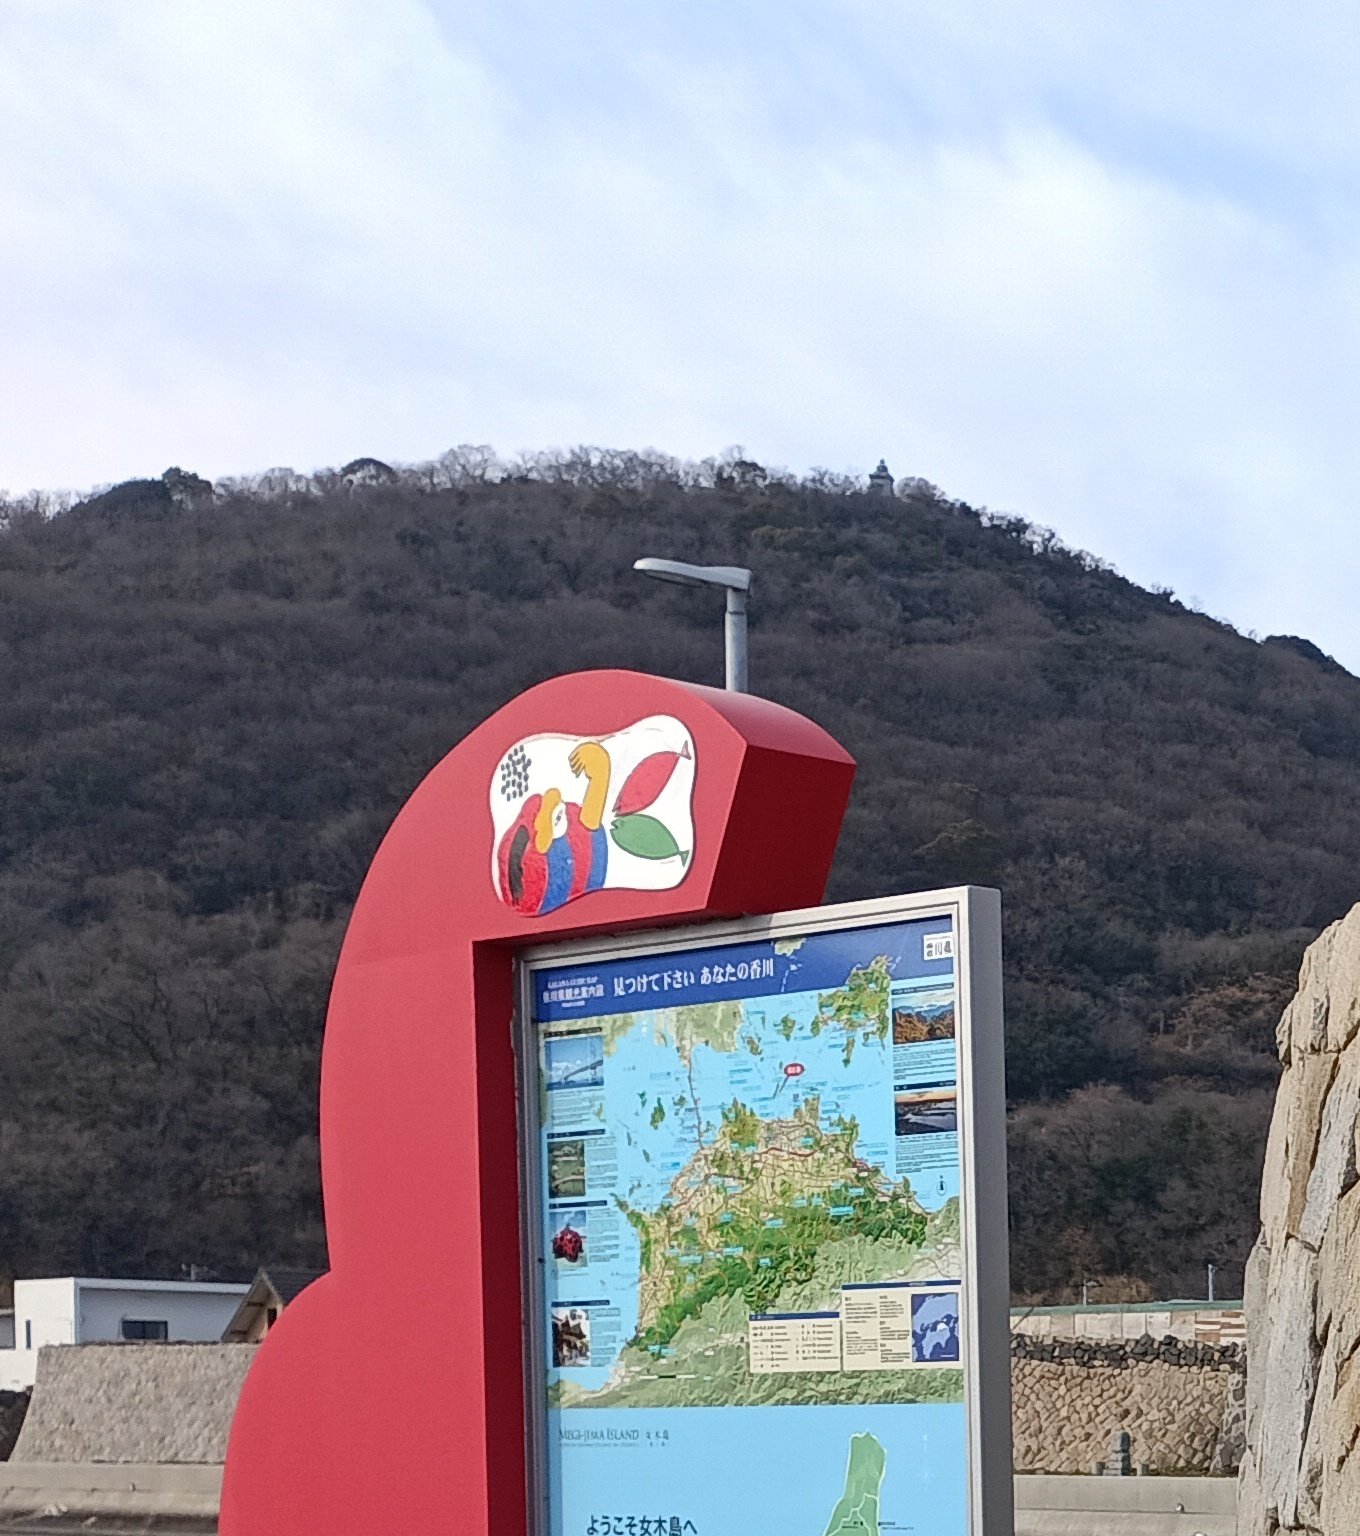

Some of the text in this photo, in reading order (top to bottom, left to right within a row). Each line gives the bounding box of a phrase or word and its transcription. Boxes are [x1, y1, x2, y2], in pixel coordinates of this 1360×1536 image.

[613, 970, 695, 997] 見つけて下さい
[700, 958, 774, 985] あなたの香川
